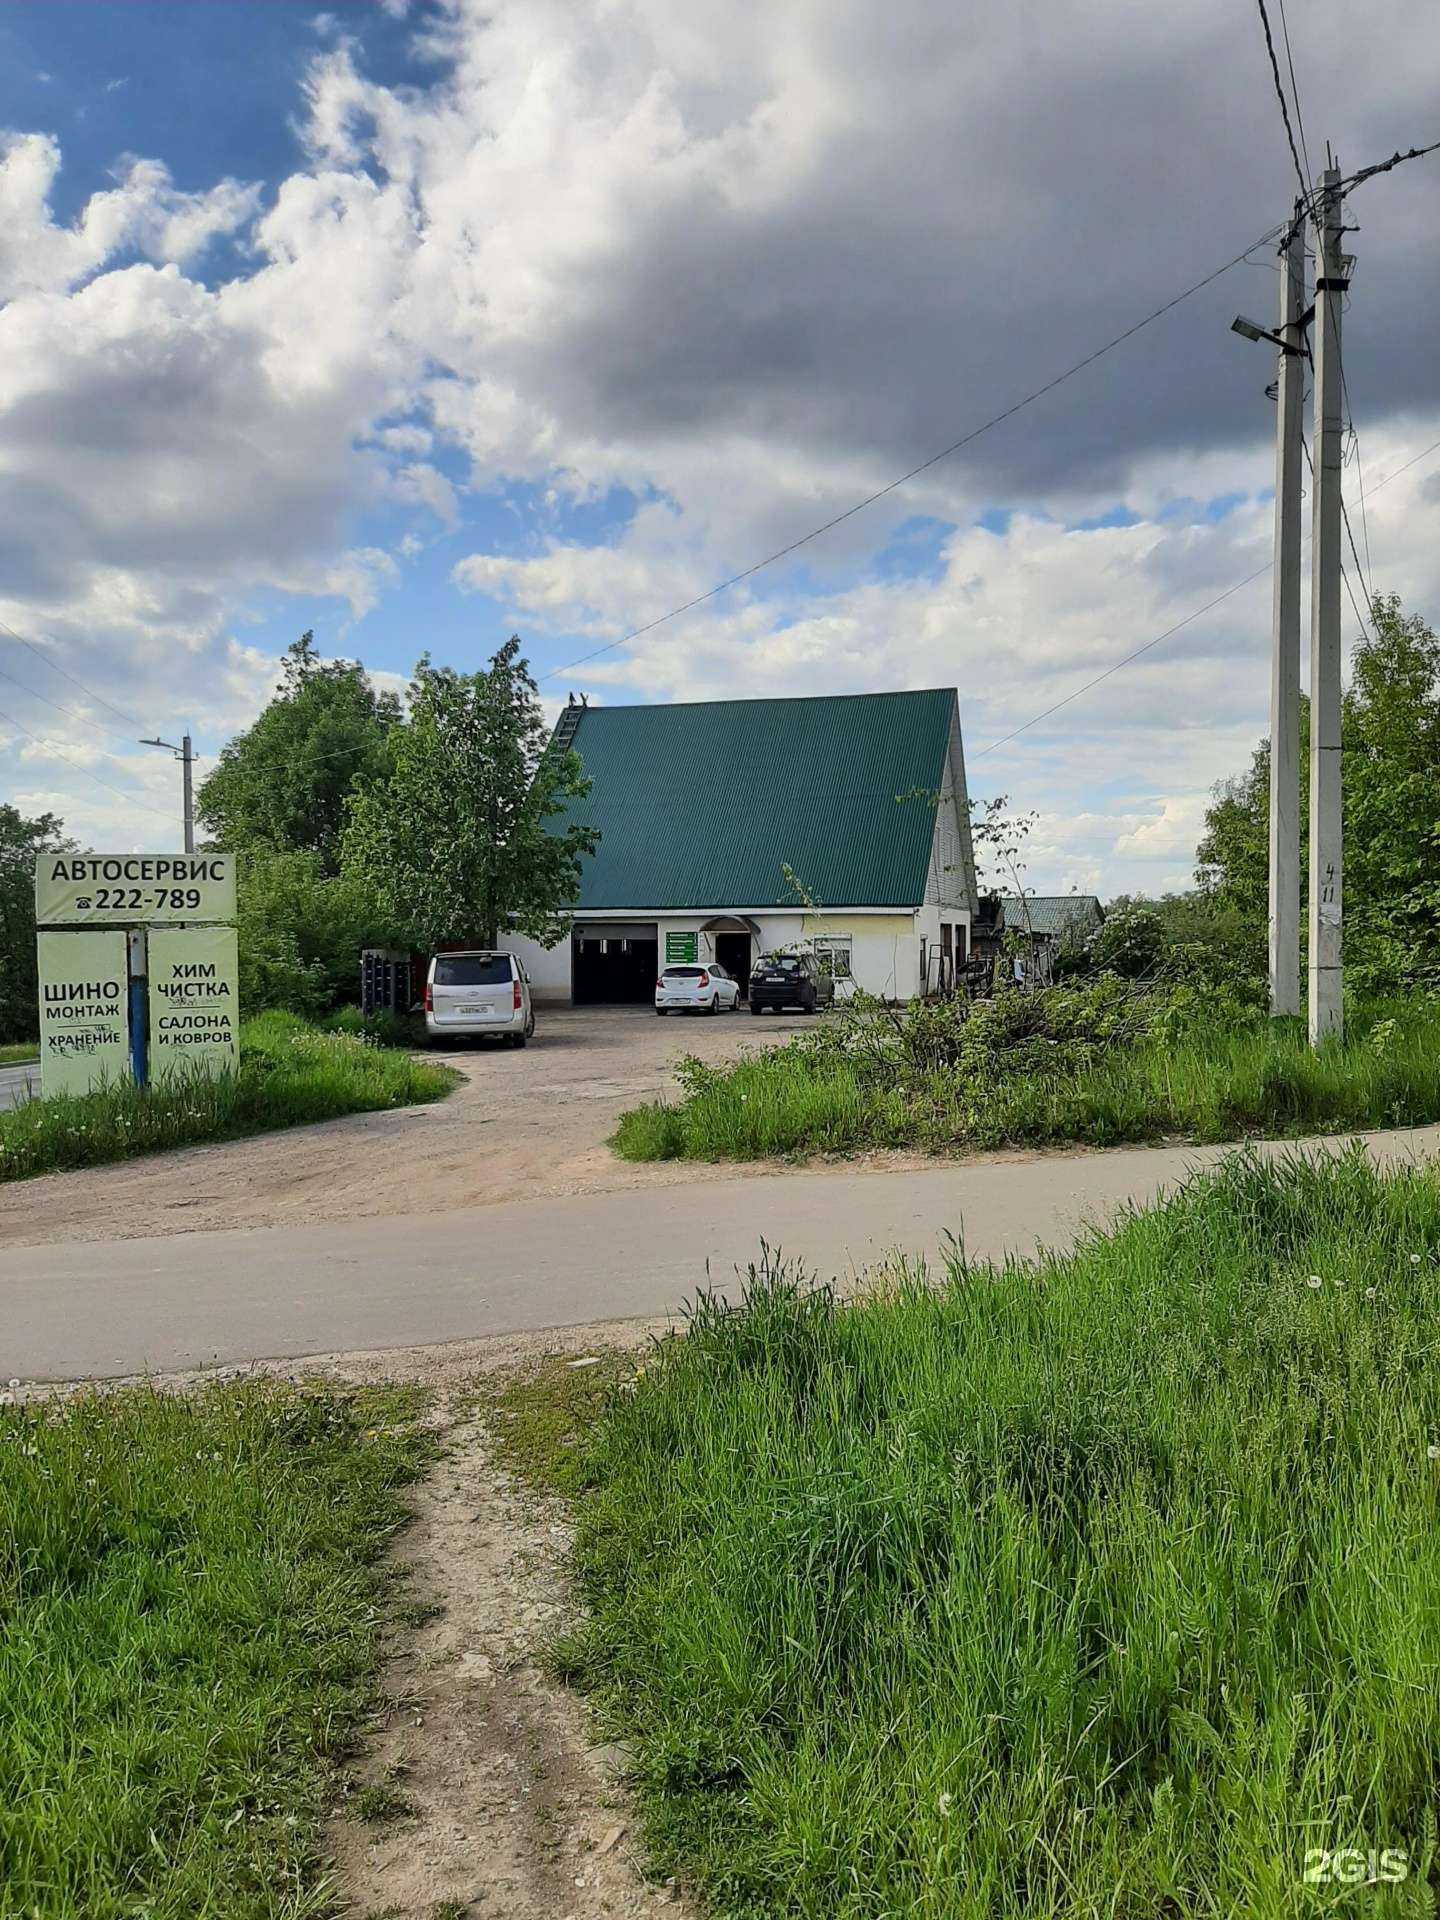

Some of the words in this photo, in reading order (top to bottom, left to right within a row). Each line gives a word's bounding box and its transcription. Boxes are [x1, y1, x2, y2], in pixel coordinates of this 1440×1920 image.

[51, 860, 225, 881] АВТОСЕРВИС
[96, 888, 201, 909] 222-789
[172, 964, 216, 978] ХИМ
[44, 981, 120, 1002] ШИНО
[157, 982, 231, 997] ЧИСТКА
[46, 1004, 120, 1019] МОНТАЖ
[158, 1015, 232, 1029] САЛОНА
[48, 1032, 121, 1047] ХРАНЕНИЕ
[158, 1034, 169, 1045] И
[173, 1032, 232, 1044] КОВРОВ
